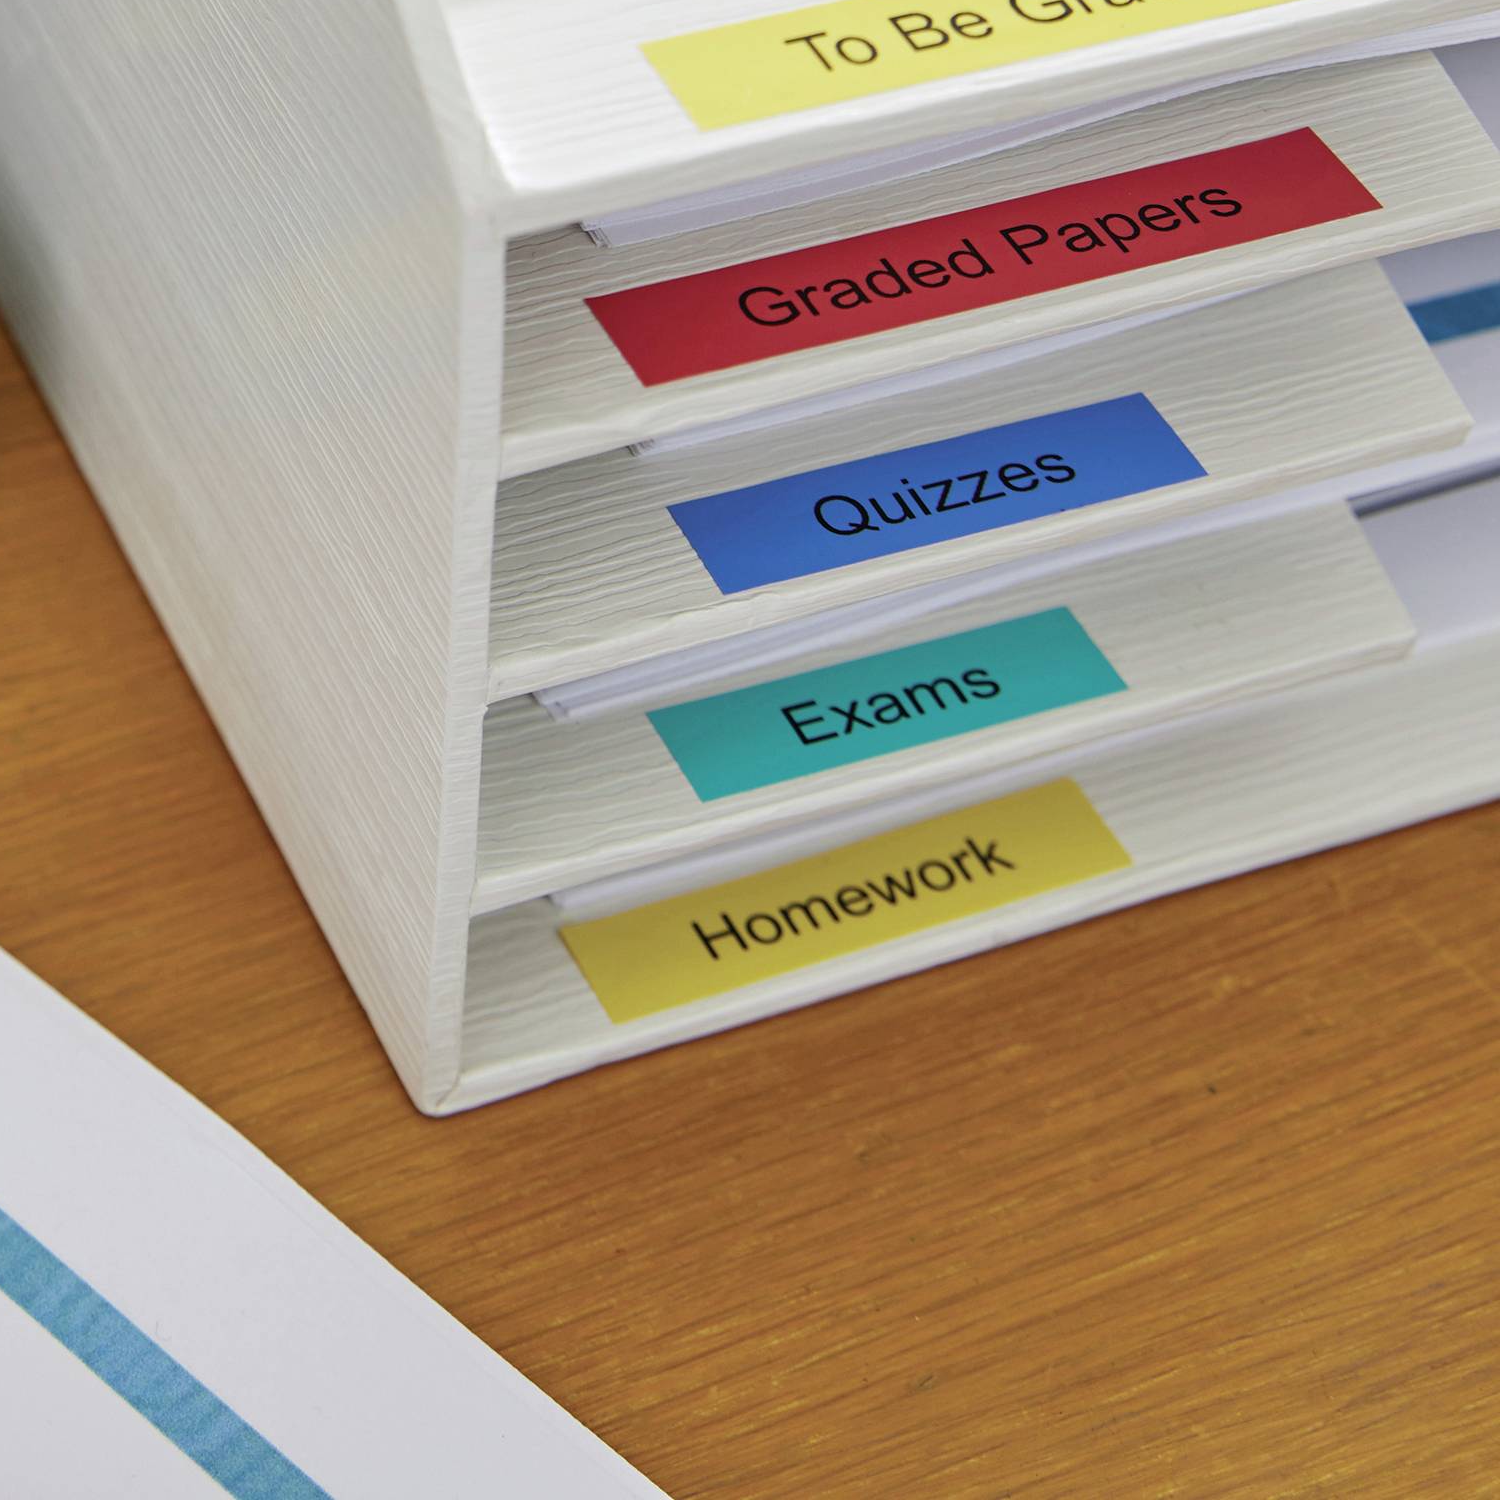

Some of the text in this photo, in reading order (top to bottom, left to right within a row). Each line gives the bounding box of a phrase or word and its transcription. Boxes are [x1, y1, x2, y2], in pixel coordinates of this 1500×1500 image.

[784, 30, 879, 73] To
[890, 8, 995, 53] Be
[738, 186, 1243, 328] Graded Papers
[813, 451, 1077, 536] Quizzes
[780, 665, 1001, 746] Exams
[691, 835, 1017, 960] Homework
